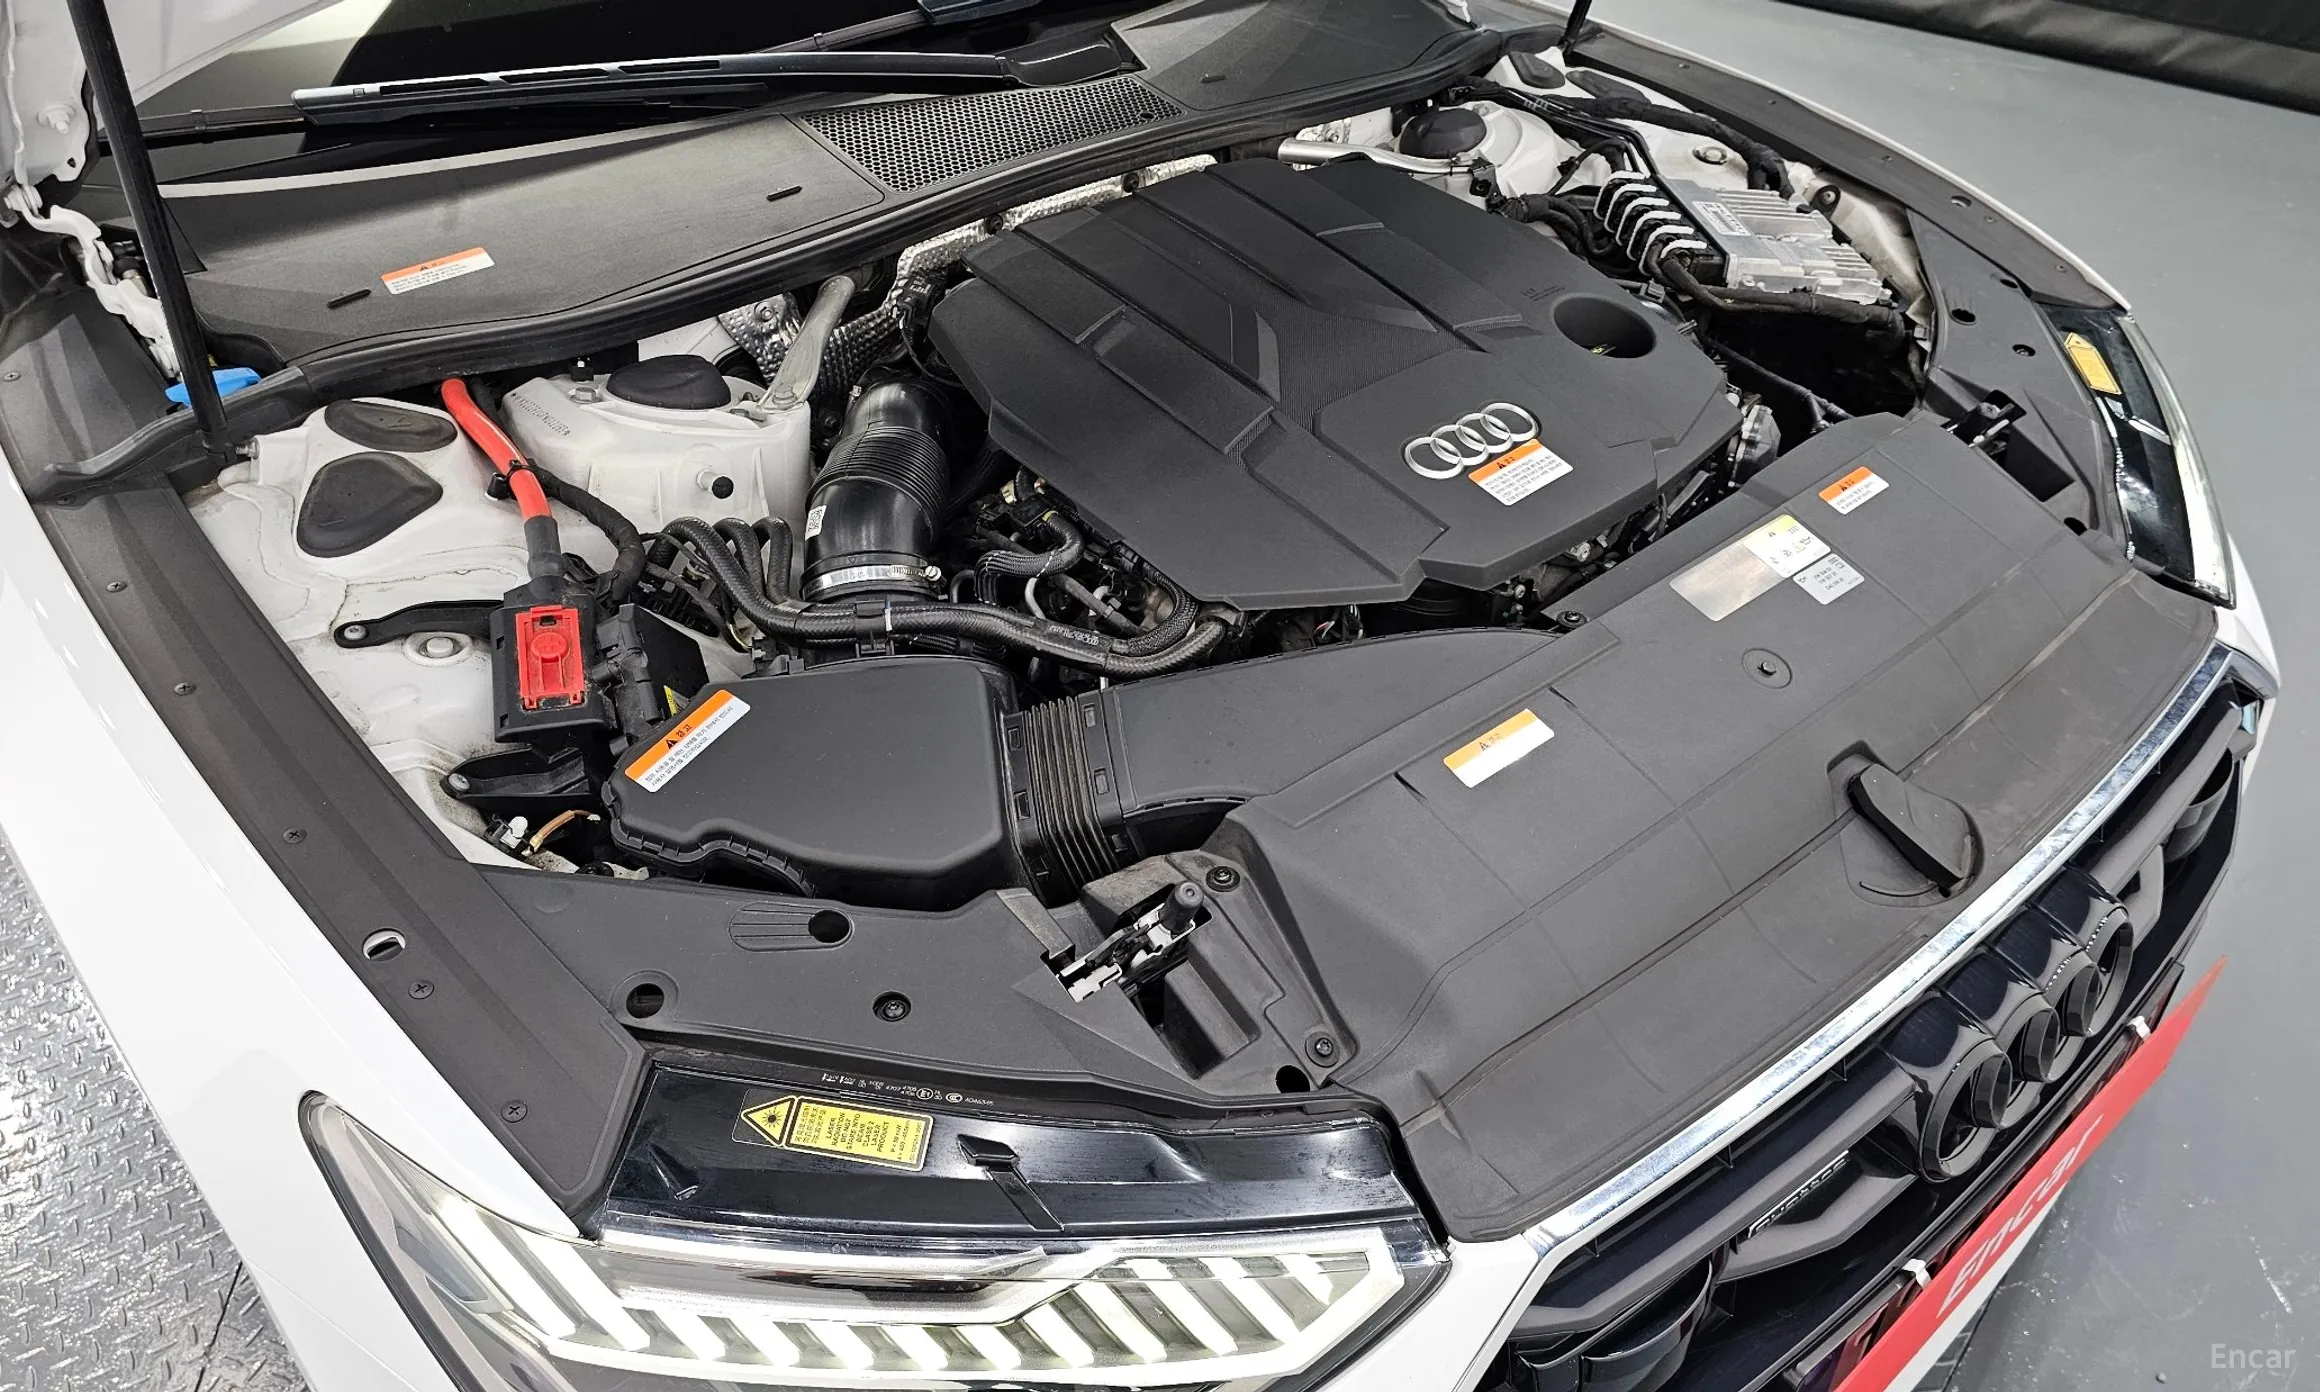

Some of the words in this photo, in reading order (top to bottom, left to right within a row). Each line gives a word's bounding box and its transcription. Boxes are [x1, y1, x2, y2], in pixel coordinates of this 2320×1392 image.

[826, 1117, 836, 1139] LASER
[831, 1112, 845, 1146] RADIATION
[870, 1124, 881, 1146] LASER
[877, 1121, 889, 1152] PRODUCT
[1936, 1115, 2104, 1319] Encar
